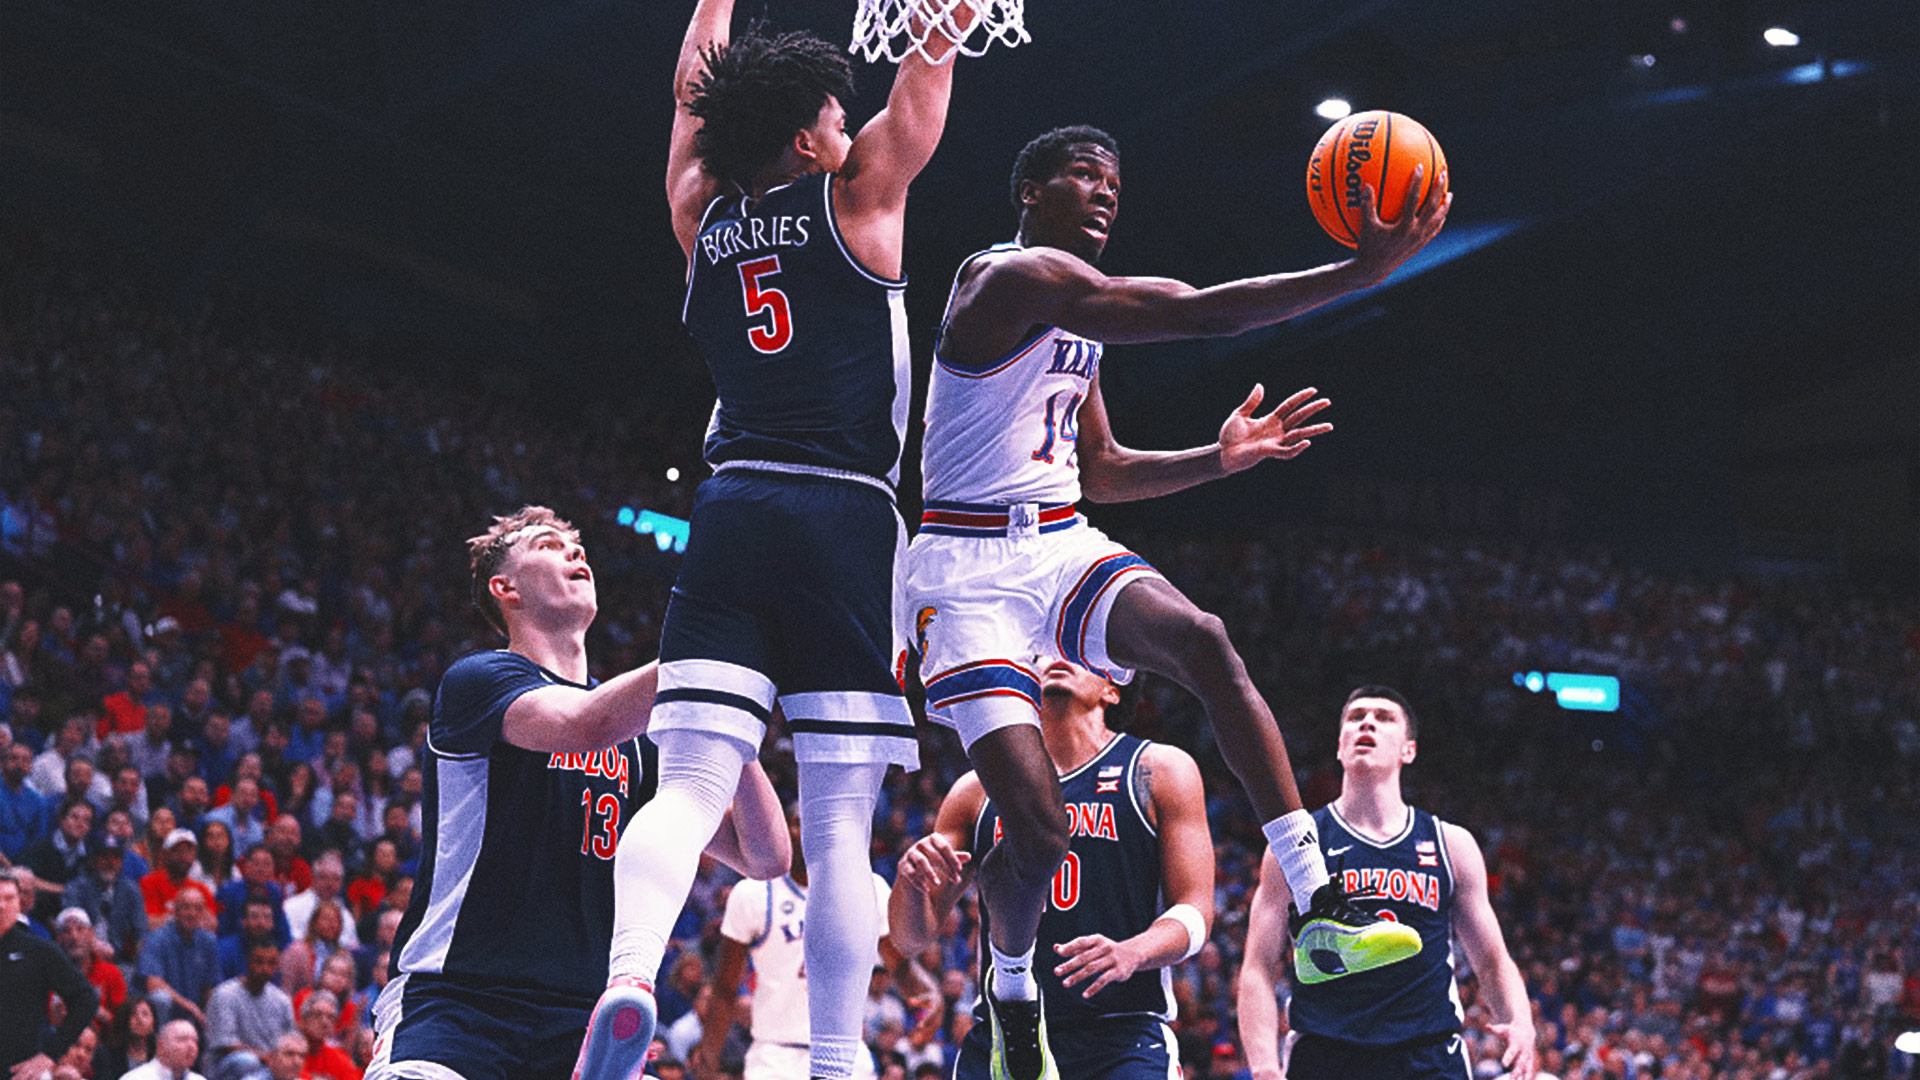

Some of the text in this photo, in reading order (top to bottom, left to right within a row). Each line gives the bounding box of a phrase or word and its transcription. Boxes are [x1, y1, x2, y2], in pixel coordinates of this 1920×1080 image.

[1345, 120, 1379, 208] Wilson
[702, 215, 810, 265] BURRIES
[736, 254, 794, 354] 5
[580, 787, 620, 860] 13
[1331, 868, 1440, 912] RIZONA
